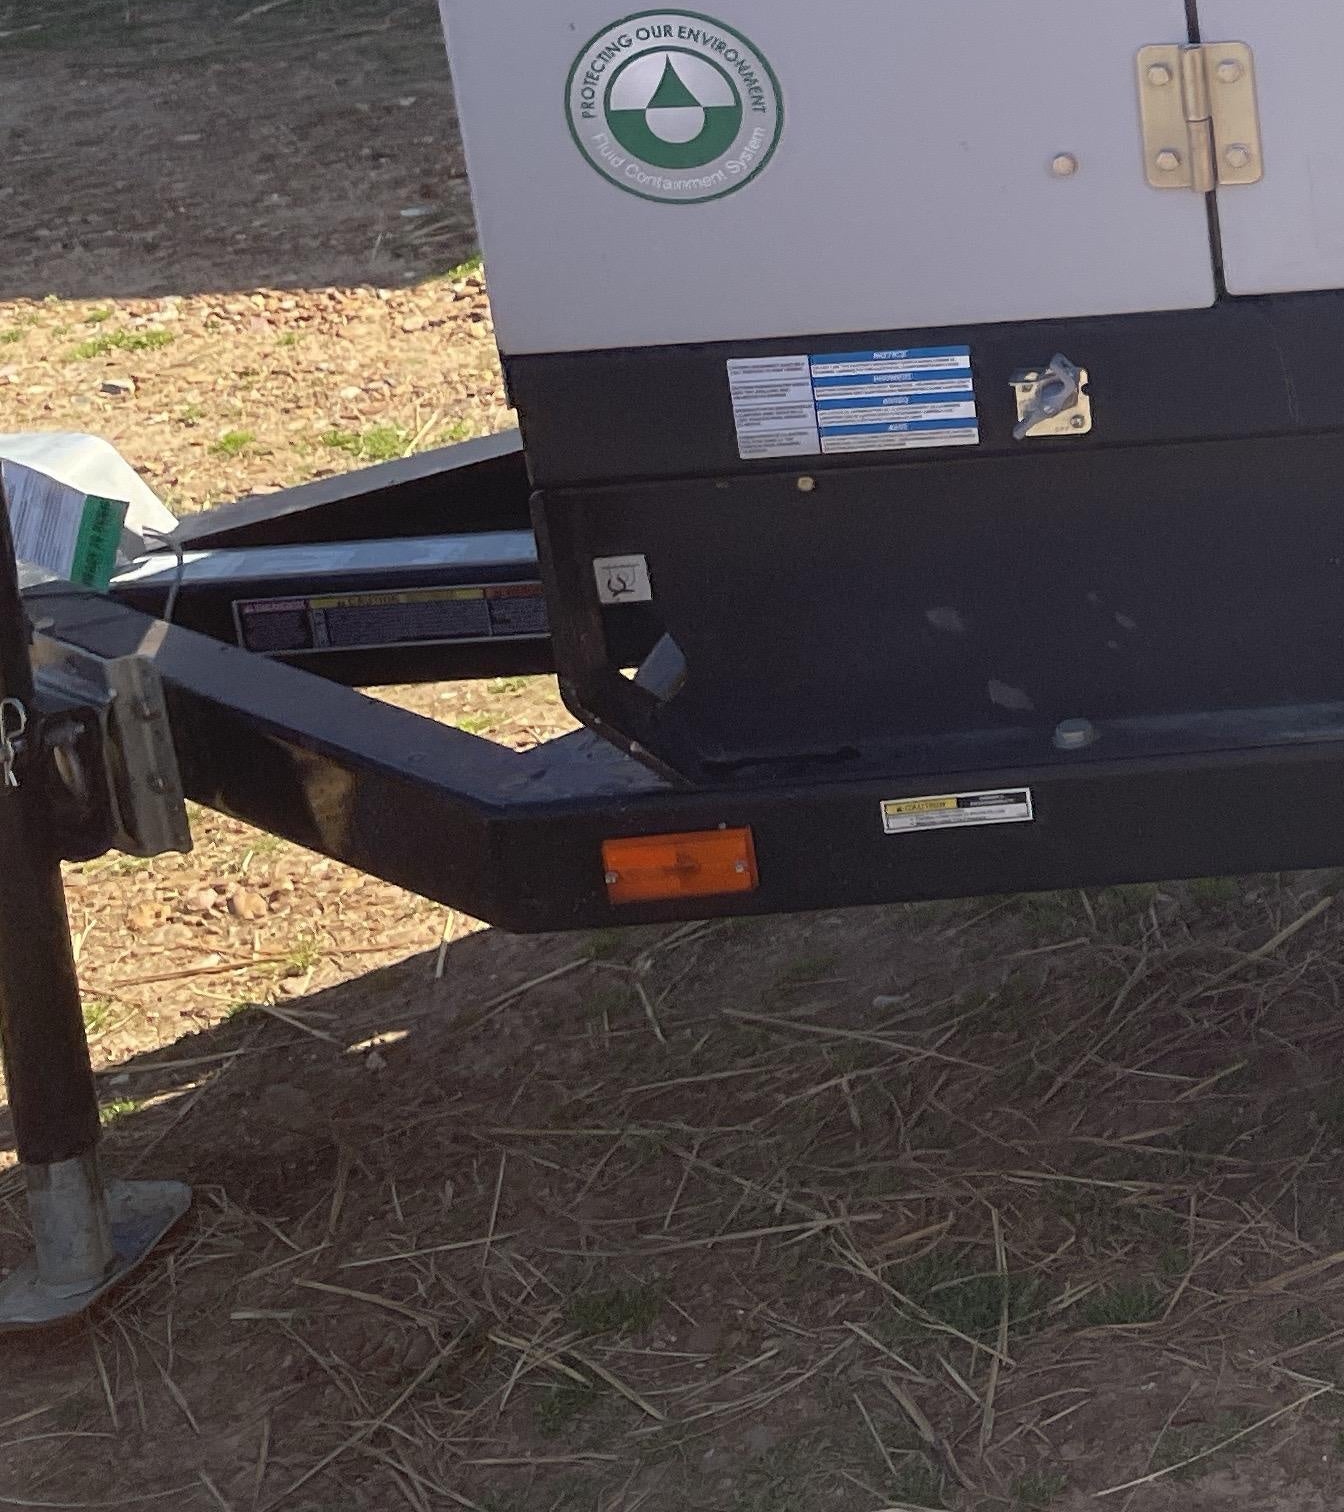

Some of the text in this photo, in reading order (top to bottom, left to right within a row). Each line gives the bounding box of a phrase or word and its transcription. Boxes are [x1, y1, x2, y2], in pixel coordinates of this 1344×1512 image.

[581, 24, 767, 119] PROTECTING OUR ENVIRONMENT
[590, 127, 767, 192] Fluid Containment System
